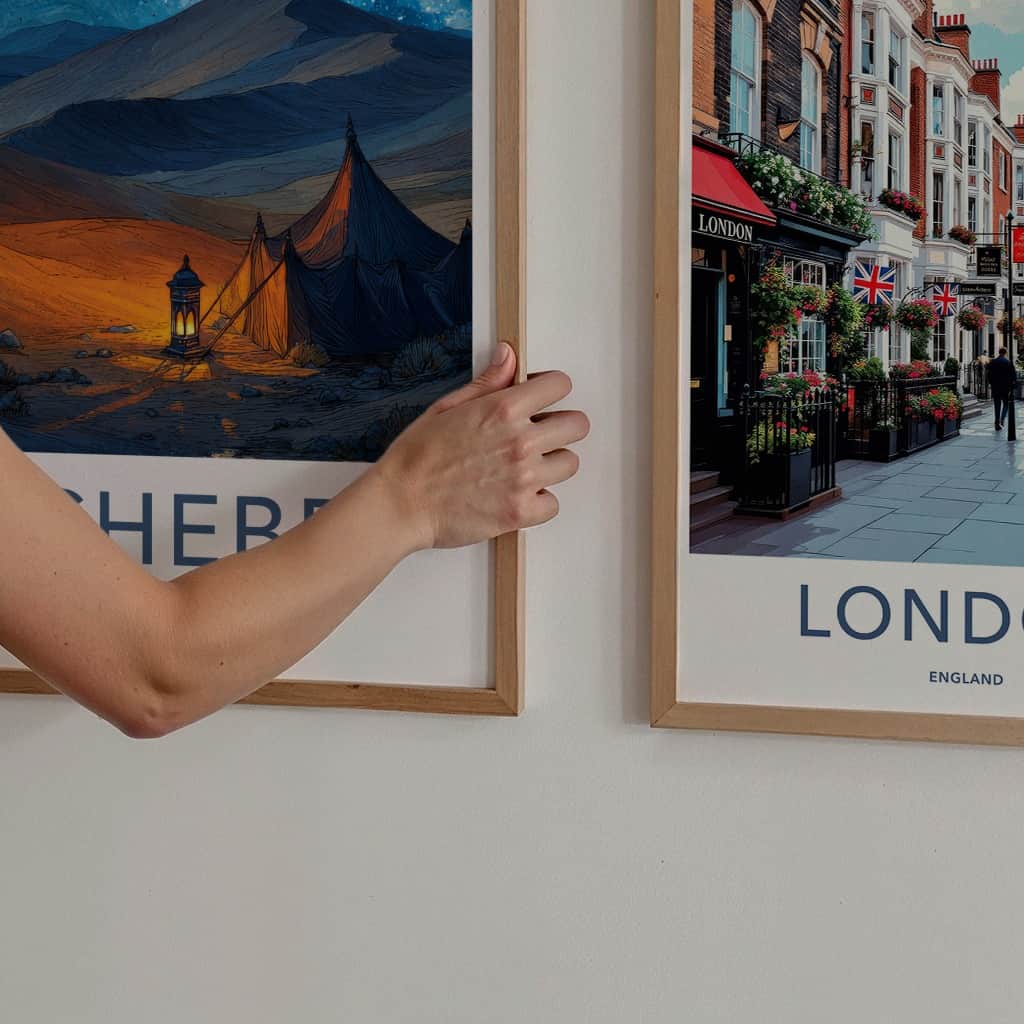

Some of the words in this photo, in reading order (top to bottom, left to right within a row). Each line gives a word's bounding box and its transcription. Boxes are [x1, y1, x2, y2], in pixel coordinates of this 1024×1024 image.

[698, 213, 753, 242] LONDON
[800, 583, 1024, 645] LOND
[929, 670, 1004, 686] ENGLAND
